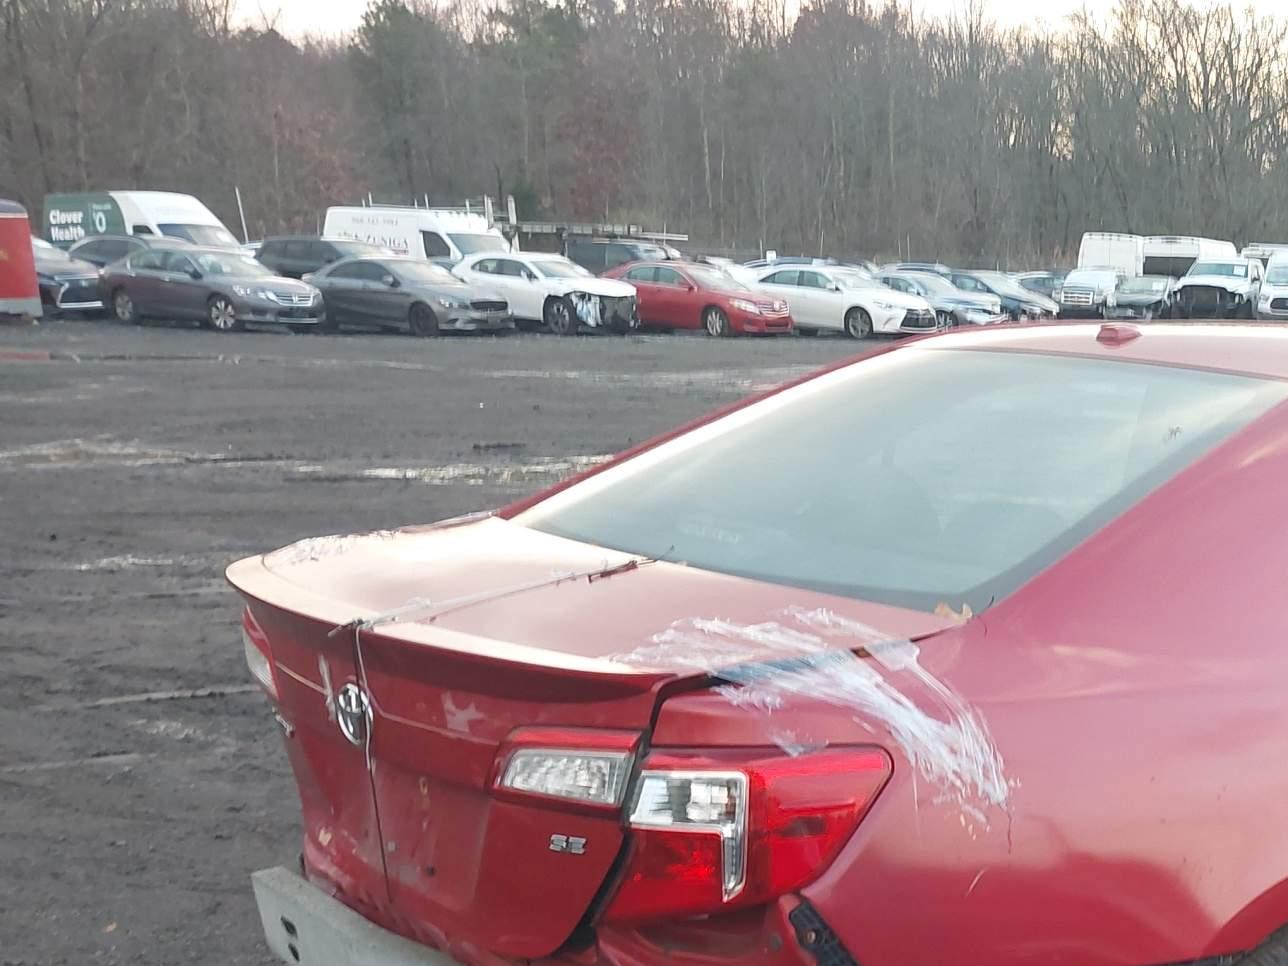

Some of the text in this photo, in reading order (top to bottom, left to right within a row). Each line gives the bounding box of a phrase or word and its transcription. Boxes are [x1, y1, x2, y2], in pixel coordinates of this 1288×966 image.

[49, 209, 83, 224] Clover
[50, 225, 85, 241] Health
[549, 834, 586, 854] SE
